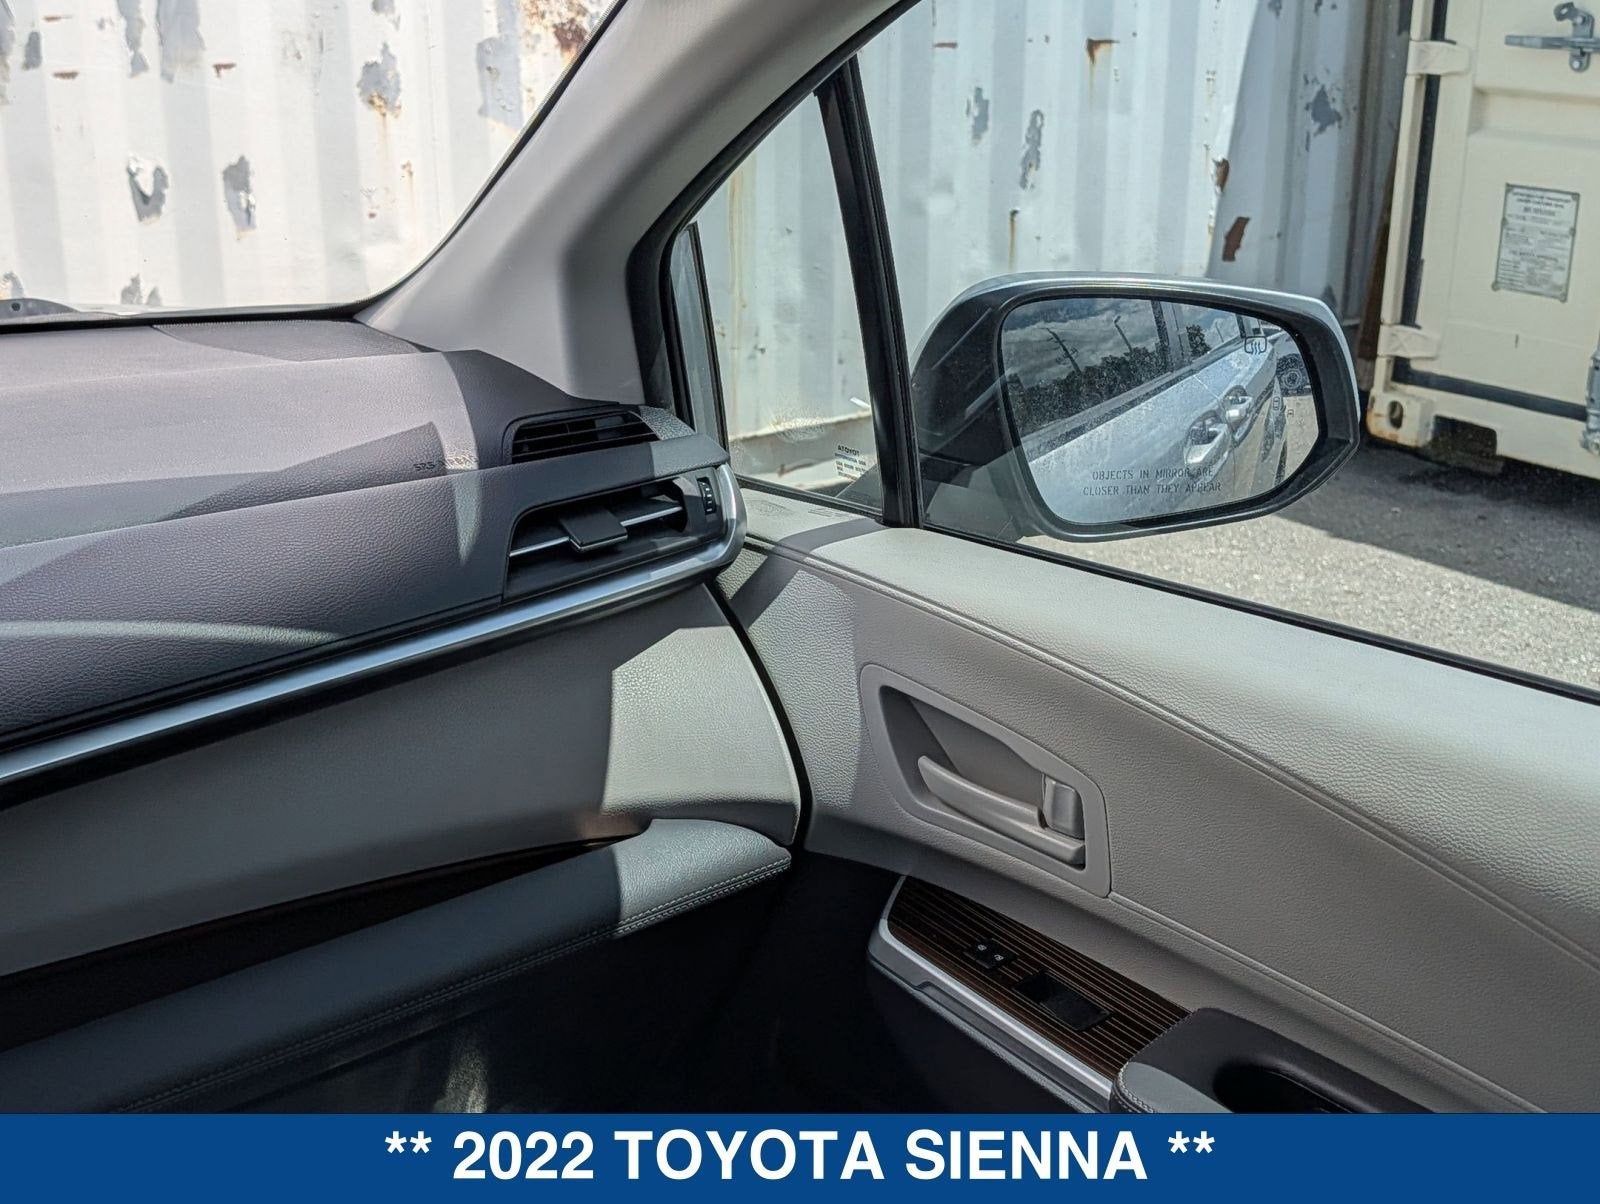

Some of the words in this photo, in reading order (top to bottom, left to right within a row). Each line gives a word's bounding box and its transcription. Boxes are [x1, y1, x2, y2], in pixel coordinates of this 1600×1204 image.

[1092, 469, 1134, 481] OBJECTS
[1139, 468, 1150, 480] IN
[1155, 467, 1190, 479] MIRROR
[1083, 485, 1119, 497] CLOSER
[1125, 485, 1150, 496] THAN
[1156, 483, 1180, 494] THEY
[1185, 481, 1221, 493] APPEAR
